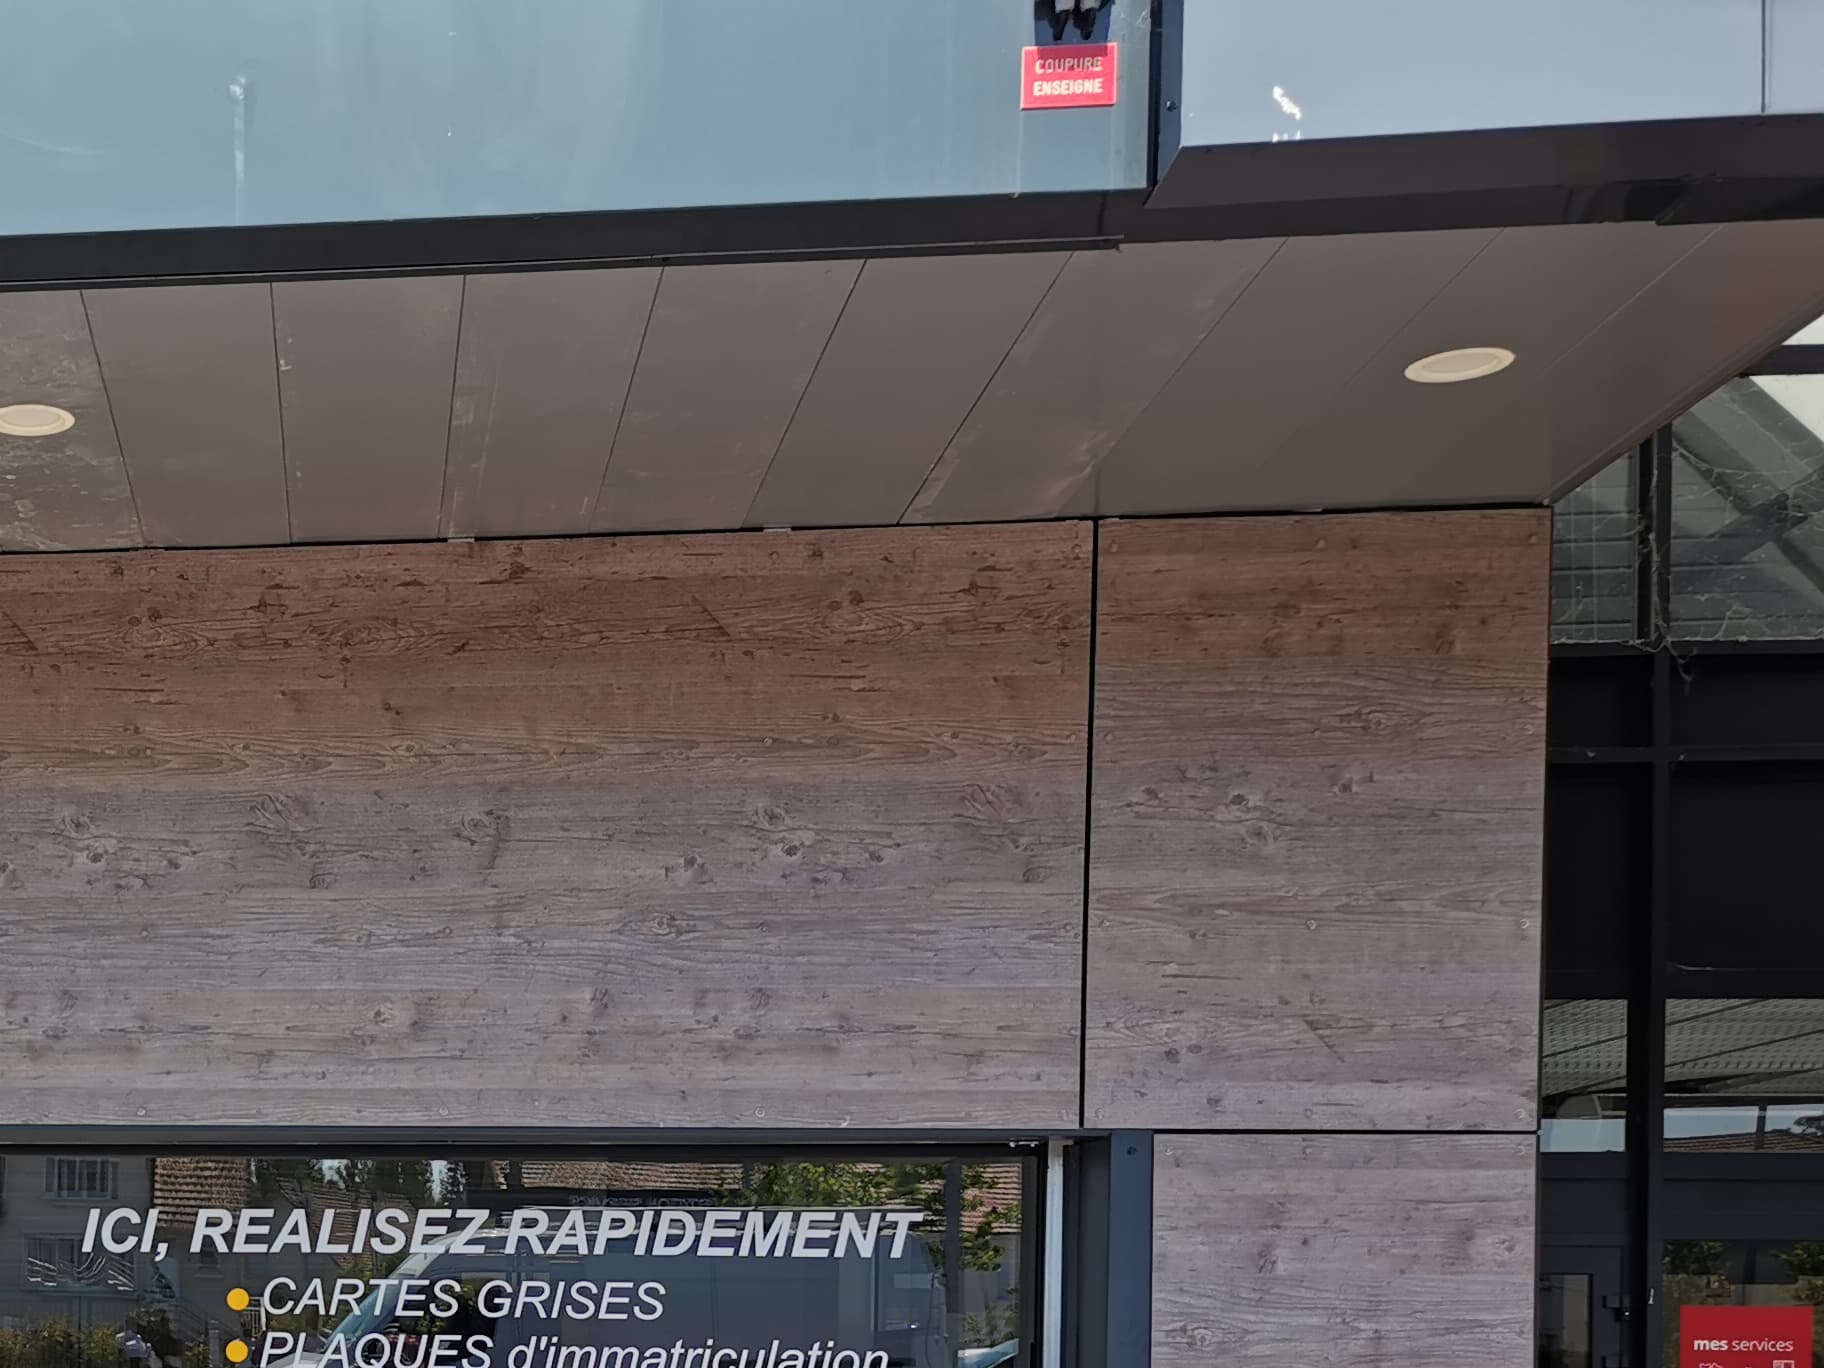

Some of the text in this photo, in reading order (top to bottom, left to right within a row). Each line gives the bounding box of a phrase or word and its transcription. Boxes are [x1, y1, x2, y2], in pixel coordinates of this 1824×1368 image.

[1035, 57, 1103, 74] COUPURE
[1033, 78, 1104, 96] ENSEIGNE
[82, 1208, 923, 1262] ICI, REALISEZ RAPIDEMENT
[263, 1277, 666, 1321] CARTES GRISES
[1693, 1339, 1794, 1352] mes services
